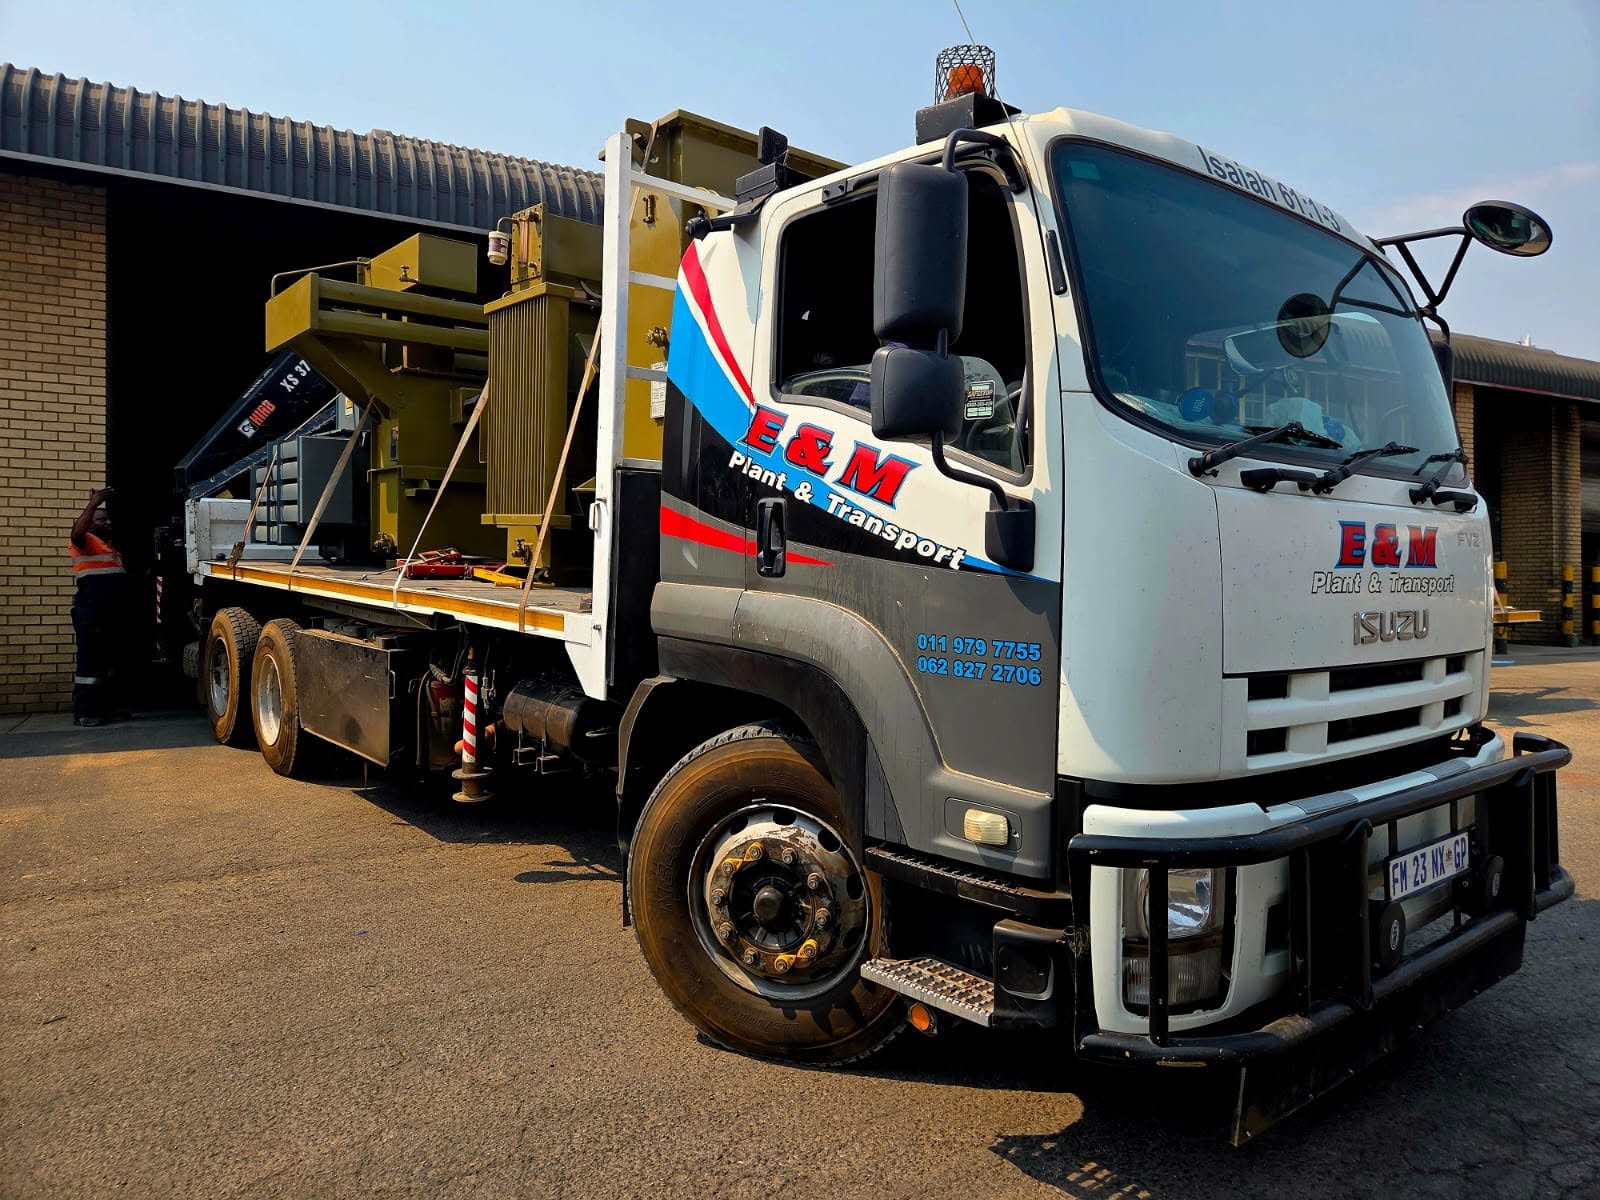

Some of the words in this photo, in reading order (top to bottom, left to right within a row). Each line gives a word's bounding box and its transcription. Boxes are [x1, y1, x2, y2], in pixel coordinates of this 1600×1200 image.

[1196, 145, 1278, 201] Isaiah
[1277, 181, 1341, 233] 61:1-3
[280, 373, 300, 392] XS
[294, 359, 311, 377] 37
[249, 399, 276, 426] HIAB
[728, 450, 787, 491] Plant
[793, 480, 815, 504] &
[826, 493, 967, 571] Transport
[1311, 571, 1361, 594] Plant
[1368, 572, 1382, 594] &
[1390, 573, 1455, 596] Transport
[1353, 608, 1429, 646] ISUZU
[917, 632, 947, 652] 011
[952, 636, 987, 656] 979
[992, 640, 1041, 661] 7755
[917, 655, 948, 675] 062
[952, 659, 987, 680] 827
[991, 664, 1041, 686] 2706
[1391, 860, 1408, 896] FM
[1413, 851, 1427, 887] 23
[1431, 845, 1446, 879] NX
[1454, 837, 1467, 870] GP
